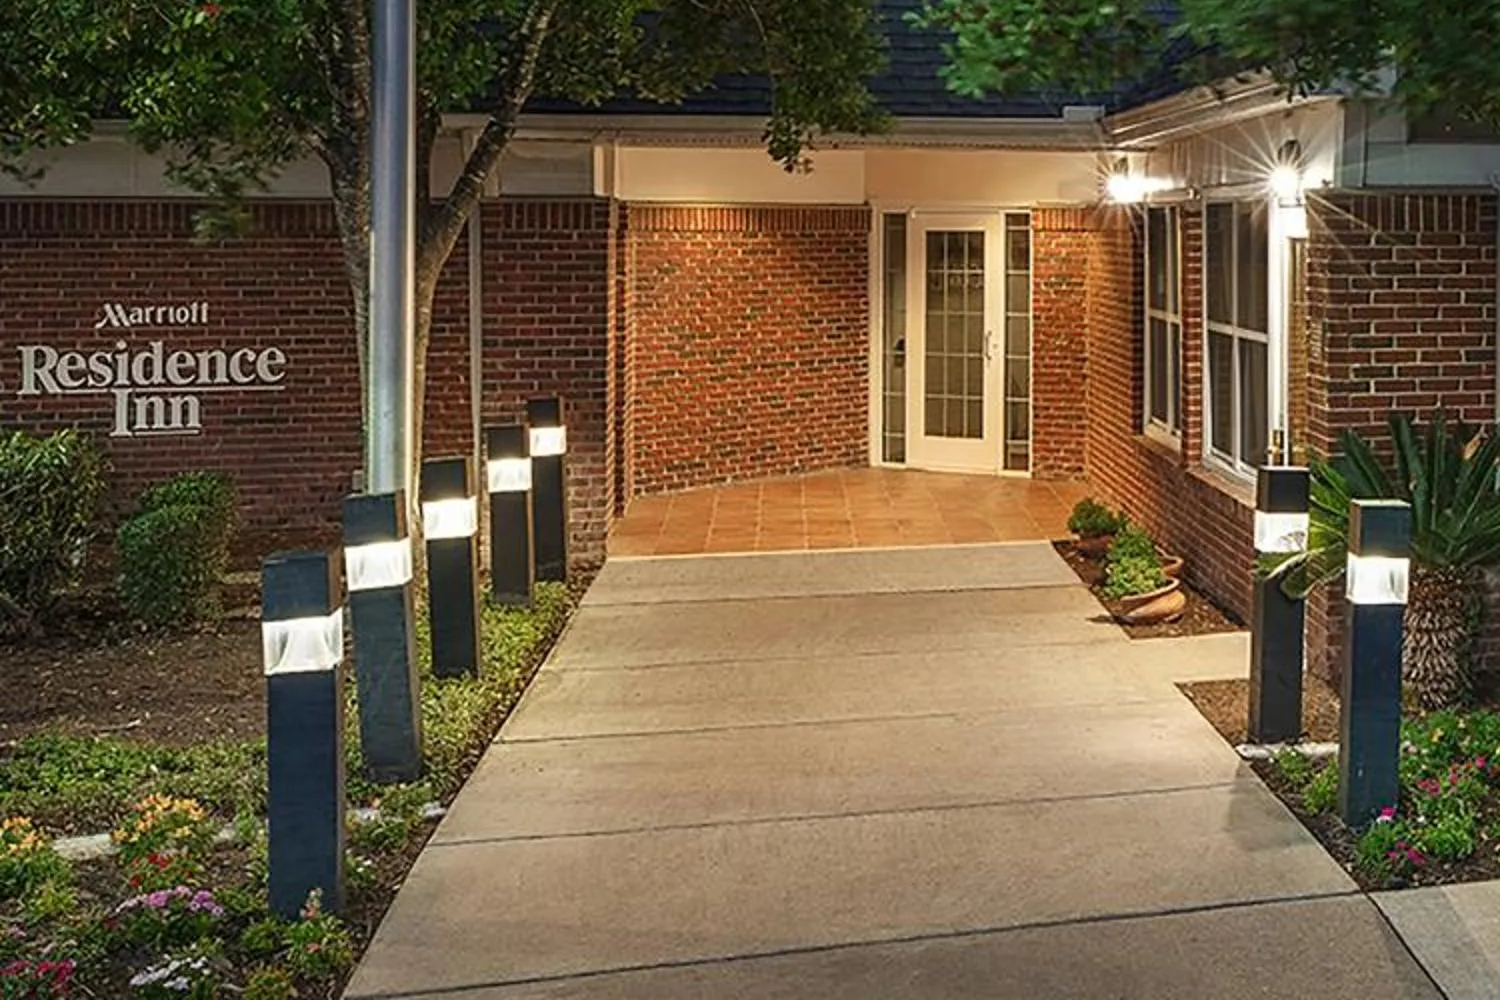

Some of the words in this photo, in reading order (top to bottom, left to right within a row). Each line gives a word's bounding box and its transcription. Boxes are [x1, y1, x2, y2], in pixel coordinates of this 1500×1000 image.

[95, 302, 209, 329] Marriott
[16, 340, 287, 395] Residence
[109, 388, 202, 437] Inn
